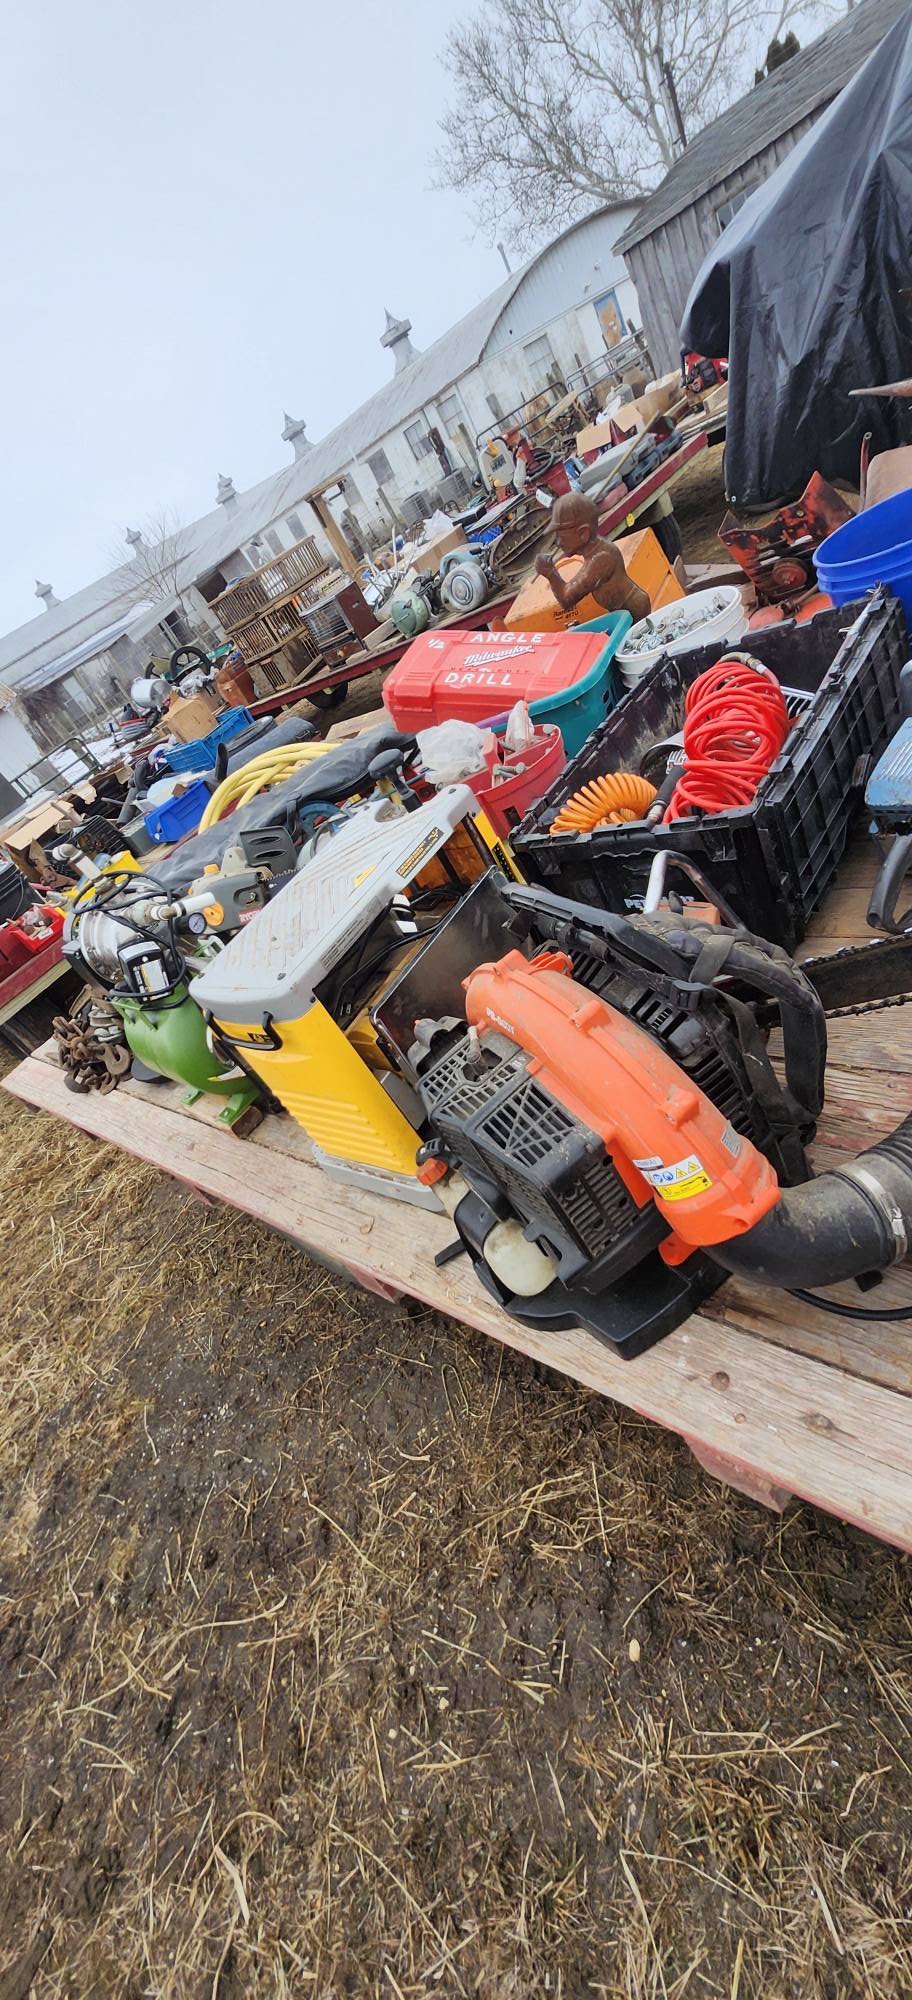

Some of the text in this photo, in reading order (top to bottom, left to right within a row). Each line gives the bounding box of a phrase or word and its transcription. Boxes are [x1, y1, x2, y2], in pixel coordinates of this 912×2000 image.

[470, 632, 546, 643] ANGLE
[463, 645, 535, 666] Milwaukee
[444, 672, 512, 686] DRILL
